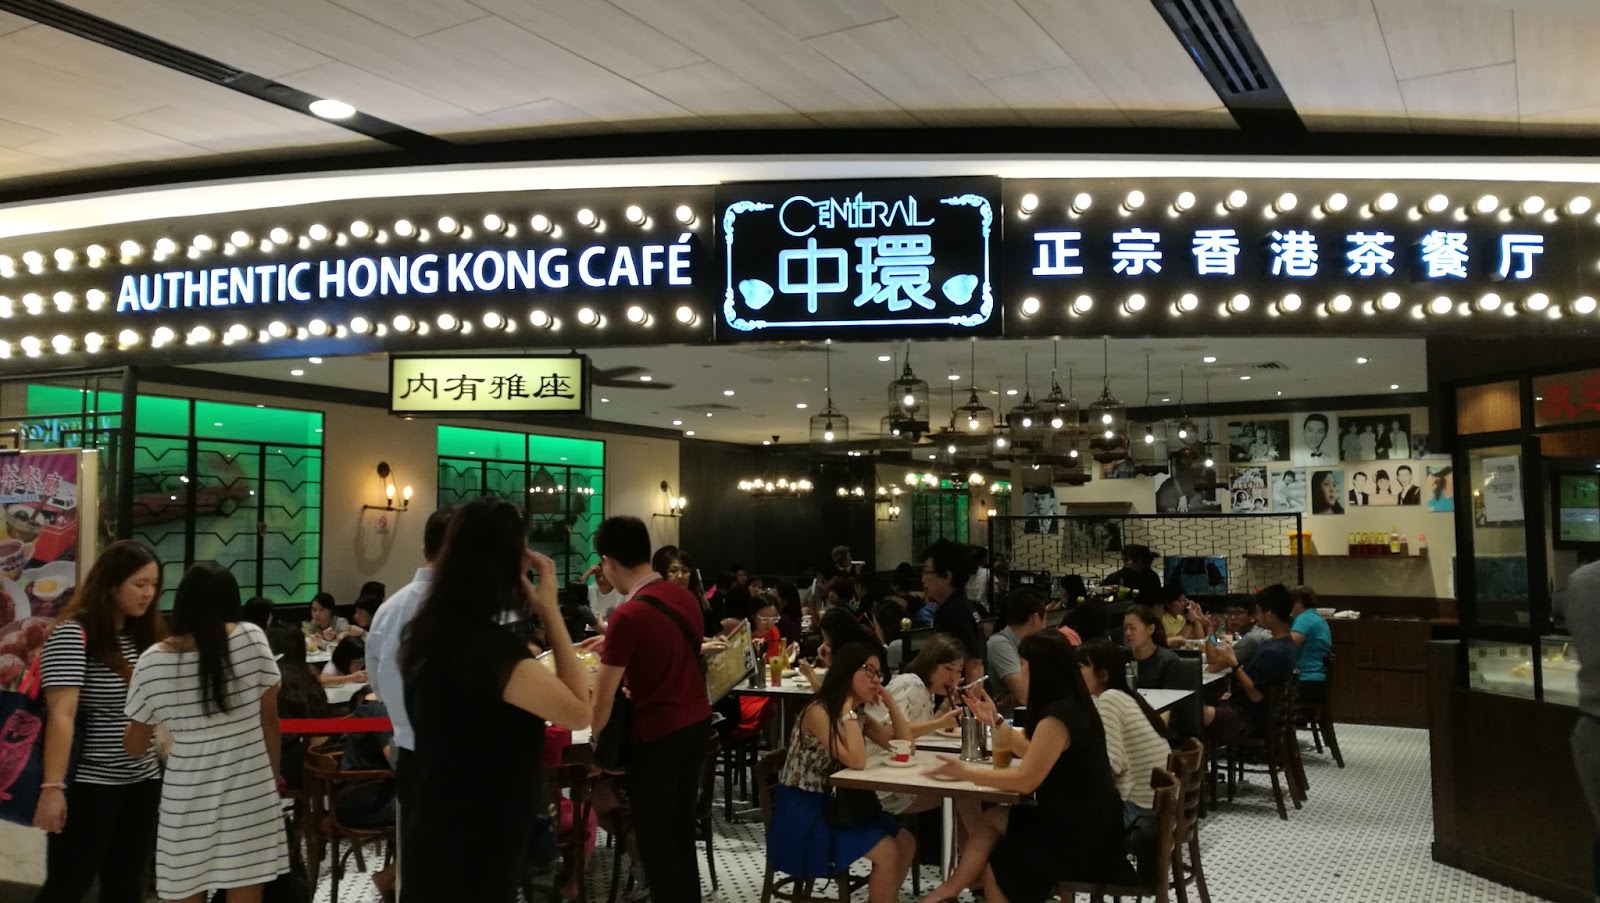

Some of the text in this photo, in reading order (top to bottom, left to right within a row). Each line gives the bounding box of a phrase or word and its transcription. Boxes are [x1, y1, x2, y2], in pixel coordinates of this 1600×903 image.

[116, 232, 692, 312] AUTHENTIC HONG KONG CAFÉ
[778, 234, 936, 313] 中環
[1032, 228, 1544, 279] 正宗香港茶餐厅
